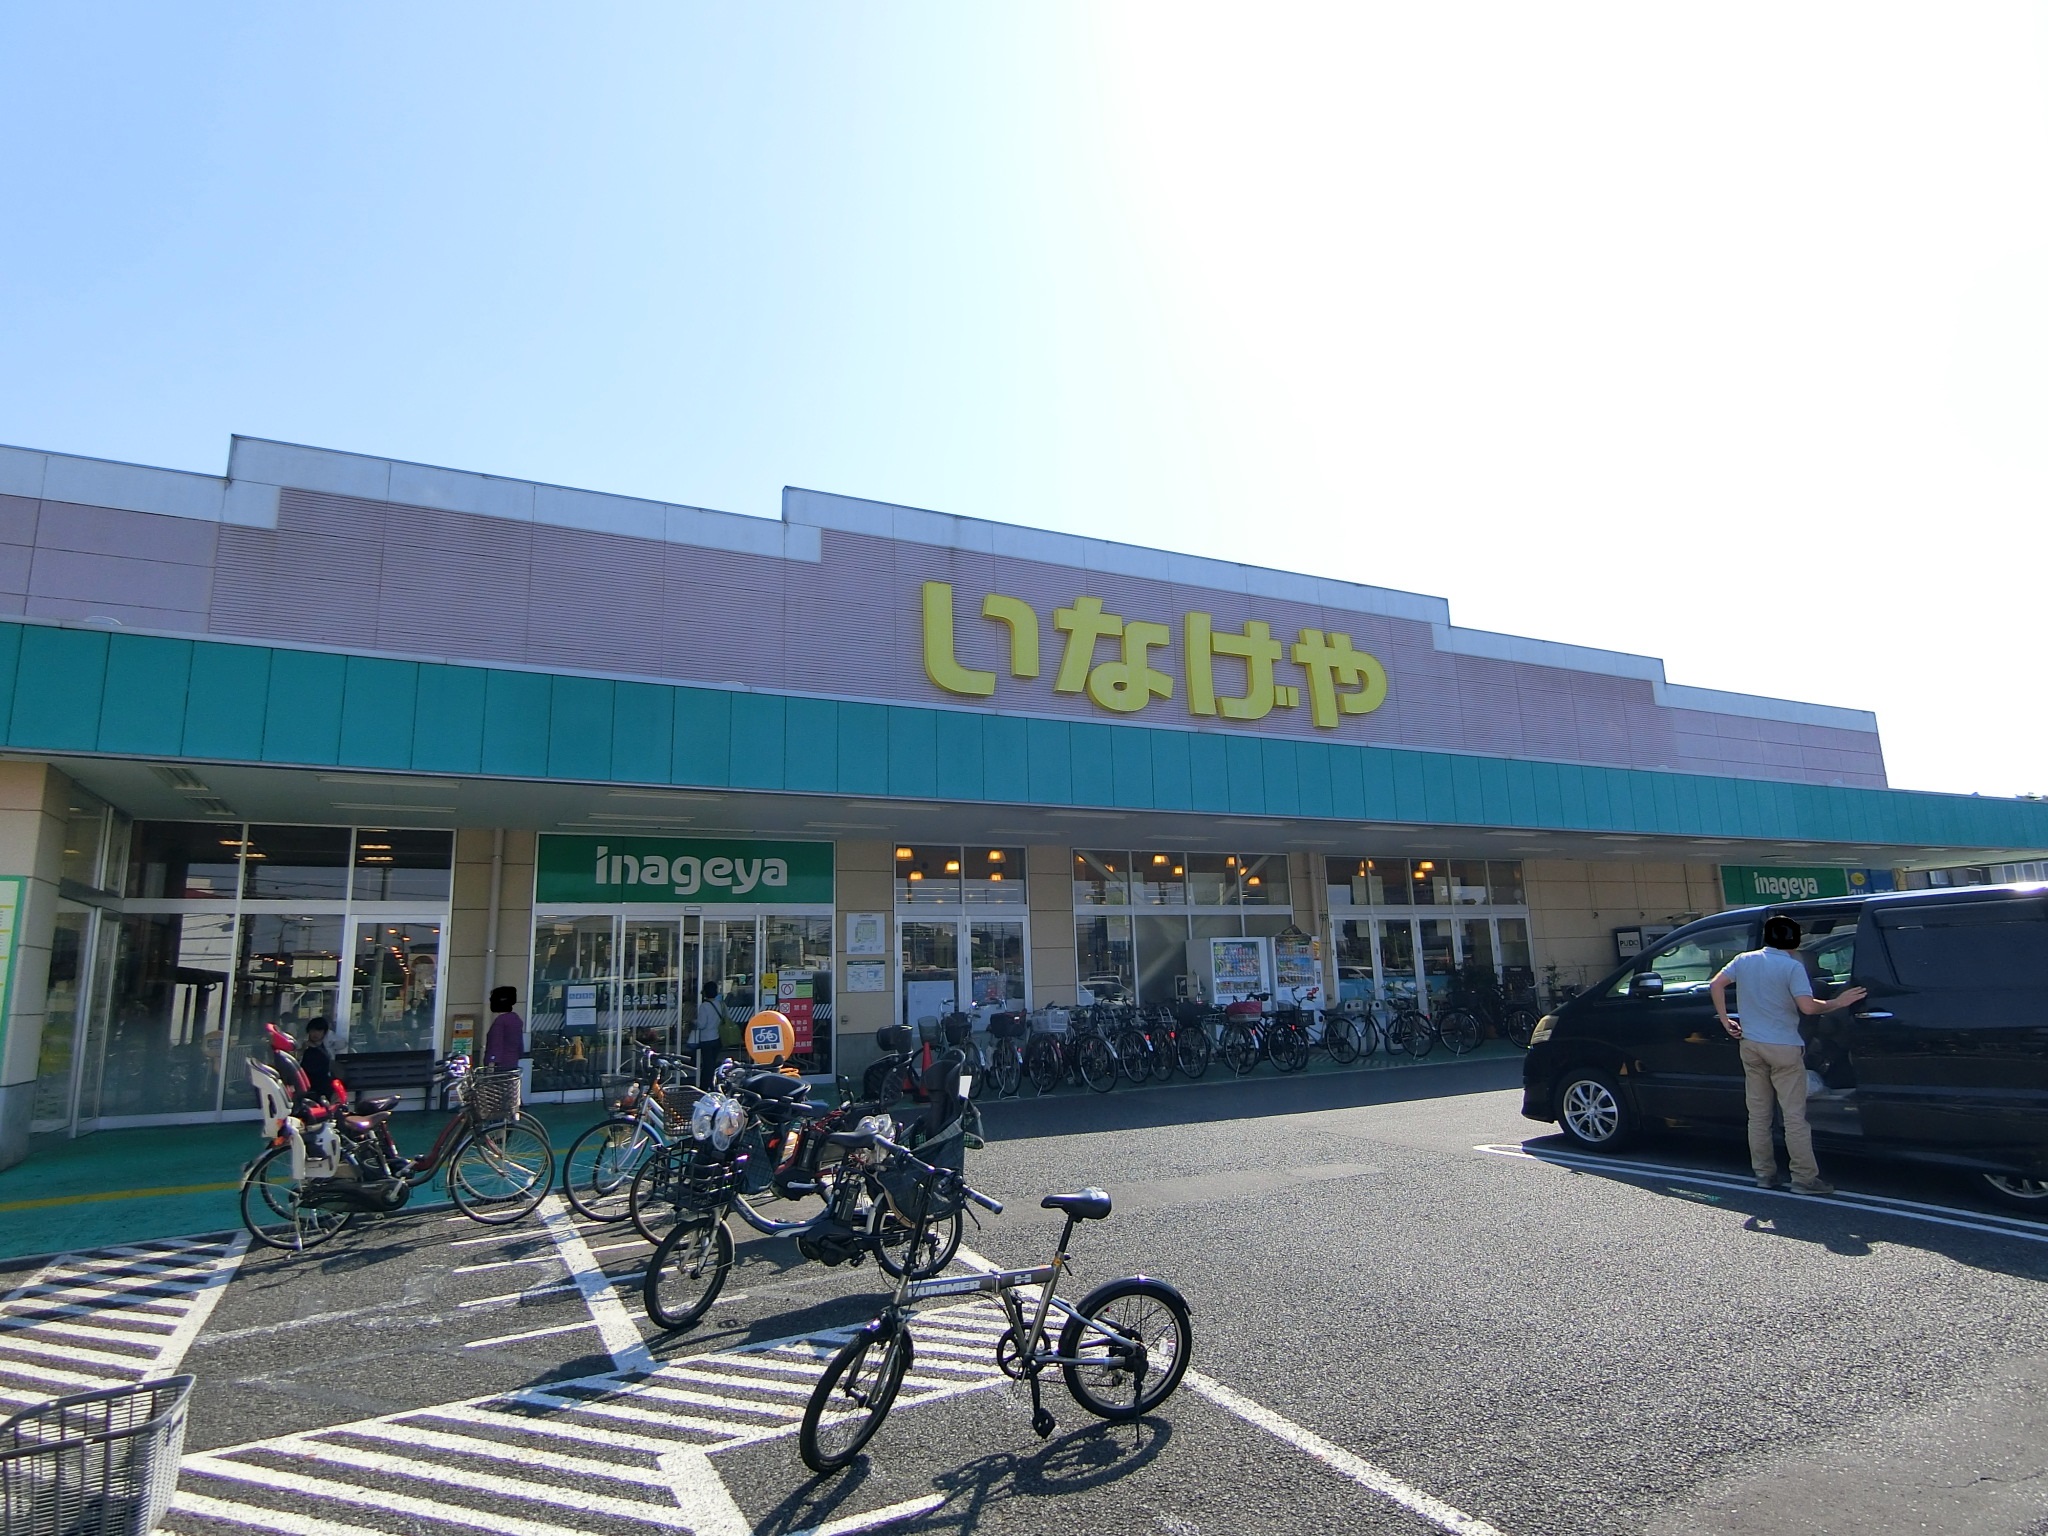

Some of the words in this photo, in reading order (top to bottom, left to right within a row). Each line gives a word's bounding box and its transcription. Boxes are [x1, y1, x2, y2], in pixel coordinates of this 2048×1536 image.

[922, 580, 1386, 729] いなげや
[596, 845, 788, 895] inageya
[1754, 872, 1818, 899] inageya
[907, 1280, 981, 1298] HUMMER
